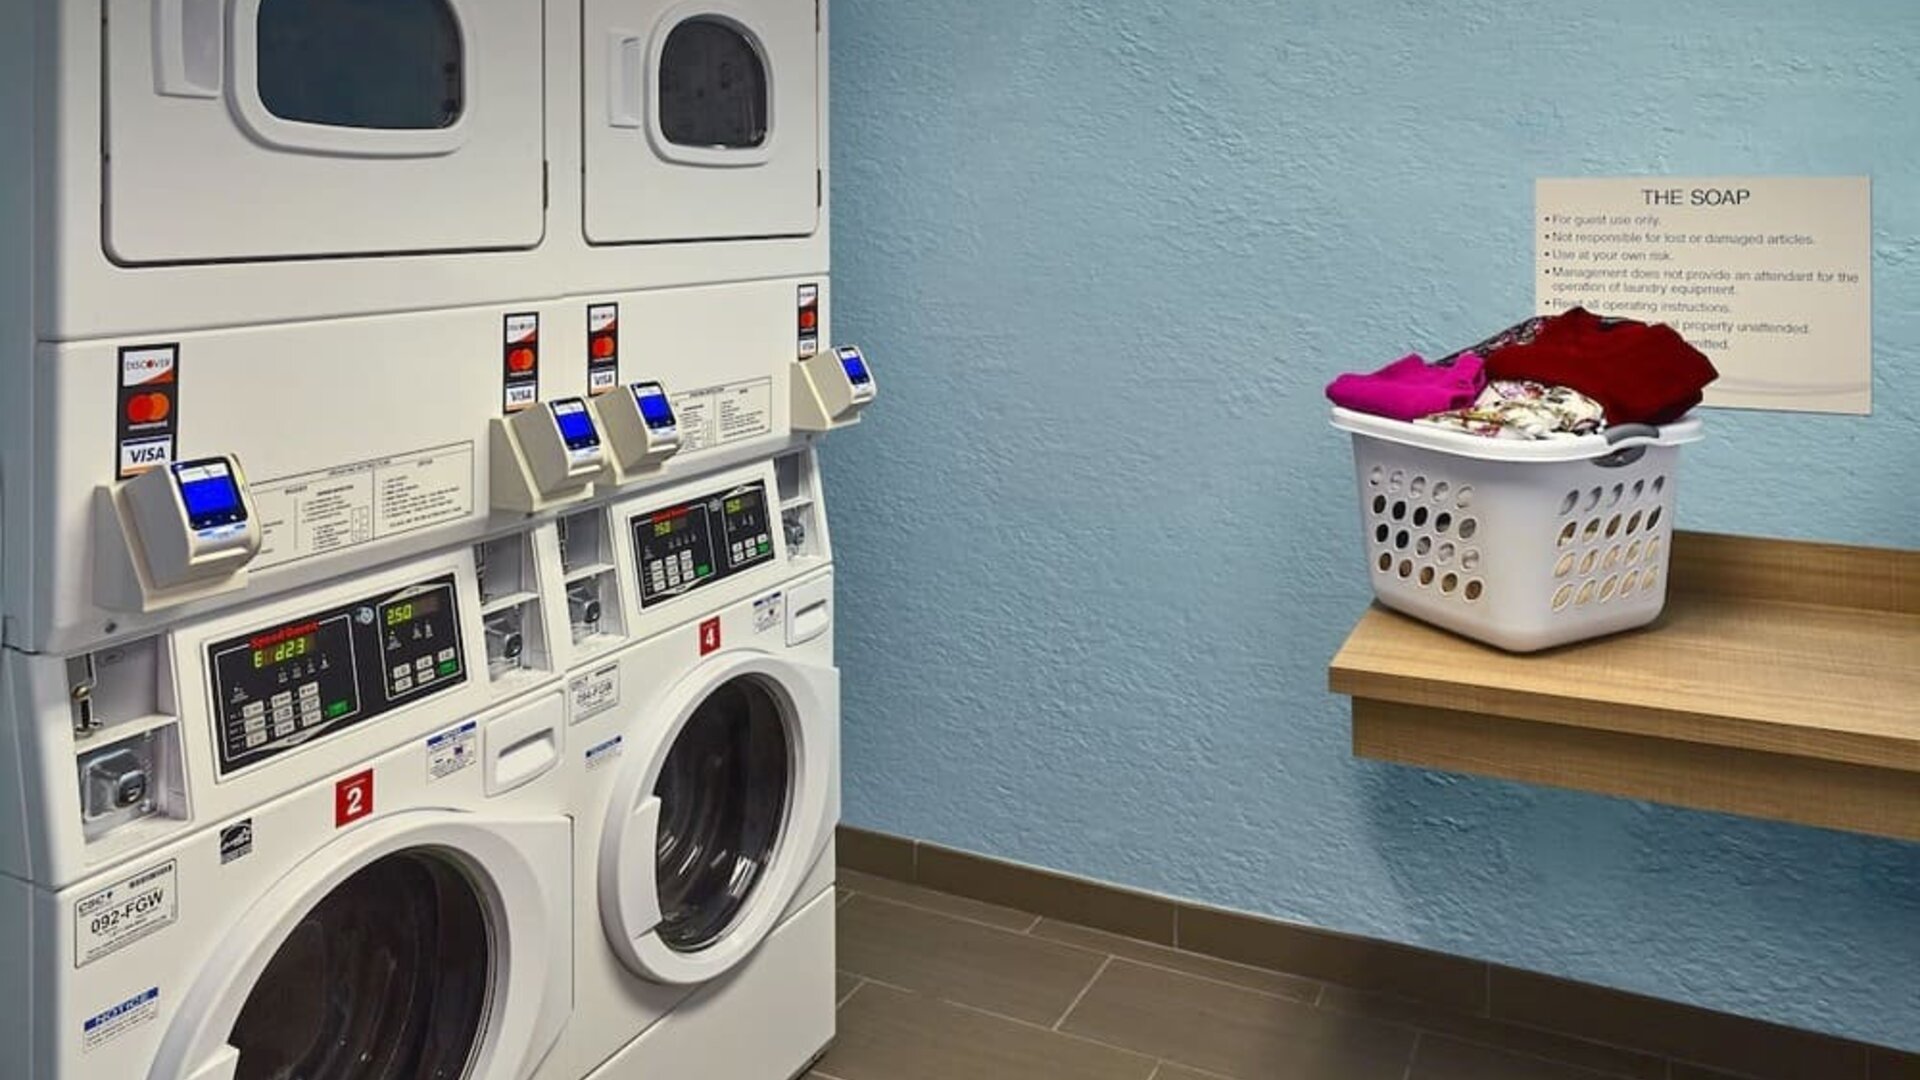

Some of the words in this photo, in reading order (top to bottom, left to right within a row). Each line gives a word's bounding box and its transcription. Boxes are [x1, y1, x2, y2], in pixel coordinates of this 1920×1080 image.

[1641, 189, 1683, 205] THE
[1690, 188, 1750, 206] SOAP
[1552, 215, 1572, 224] For
[1574, 215, 1607, 227] guest
[1610, 217, 1631, 225] use
[1635, 216, 1661, 227] only.
[1552, 232, 1573, 243] Not
[1575, 233, 1642, 245] responsible
[1645, 233, 1661, 243] for
[1664, 234, 1686, 244] lost
[1689, 236, 1702, 244] or
[1705, 234, 1763, 247] damaged
[1767, 234, 1815, 246] articles.
[1552, 249, 1575, 260] Use
[1578, 250, 1590, 260] at
[1592, 252, 1618, 263] your
[1621, 252, 1646, 261] own
[1649, 251, 1674, 262] risk.
[1552, 266, 1627, 280] Management
[1631, 269, 1661, 279] does
[1664, 270, 1683, 280] not
[1686, 270, 1731, 283] provide
[1734, 272, 1751, 281] an
[1754, 270, 1813, 282] attendant
[1817, 271, 1834, 283] for
[1838, 272, 1859, 284] the
[1552, 281, 1605, 292] operation
[1608, 281, 1621, 292] of
[1623, 283, 1667, 294] laundry
[1671, 284, 1736, 296] equipment.
[1587, 299, 1600, 309] all
[1602, 300, 1658, 313] operating
[1660, 301, 1731, 314] instructions.
[1682, 320, 1734, 333] property
[130, 447, 166, 463] VISA
[705, 627, 715, 648] 4
[275, 637, 306, 662] d23
[346, 787, 363, 815] 2
[91, 888, 163, 934] 092-FGW
